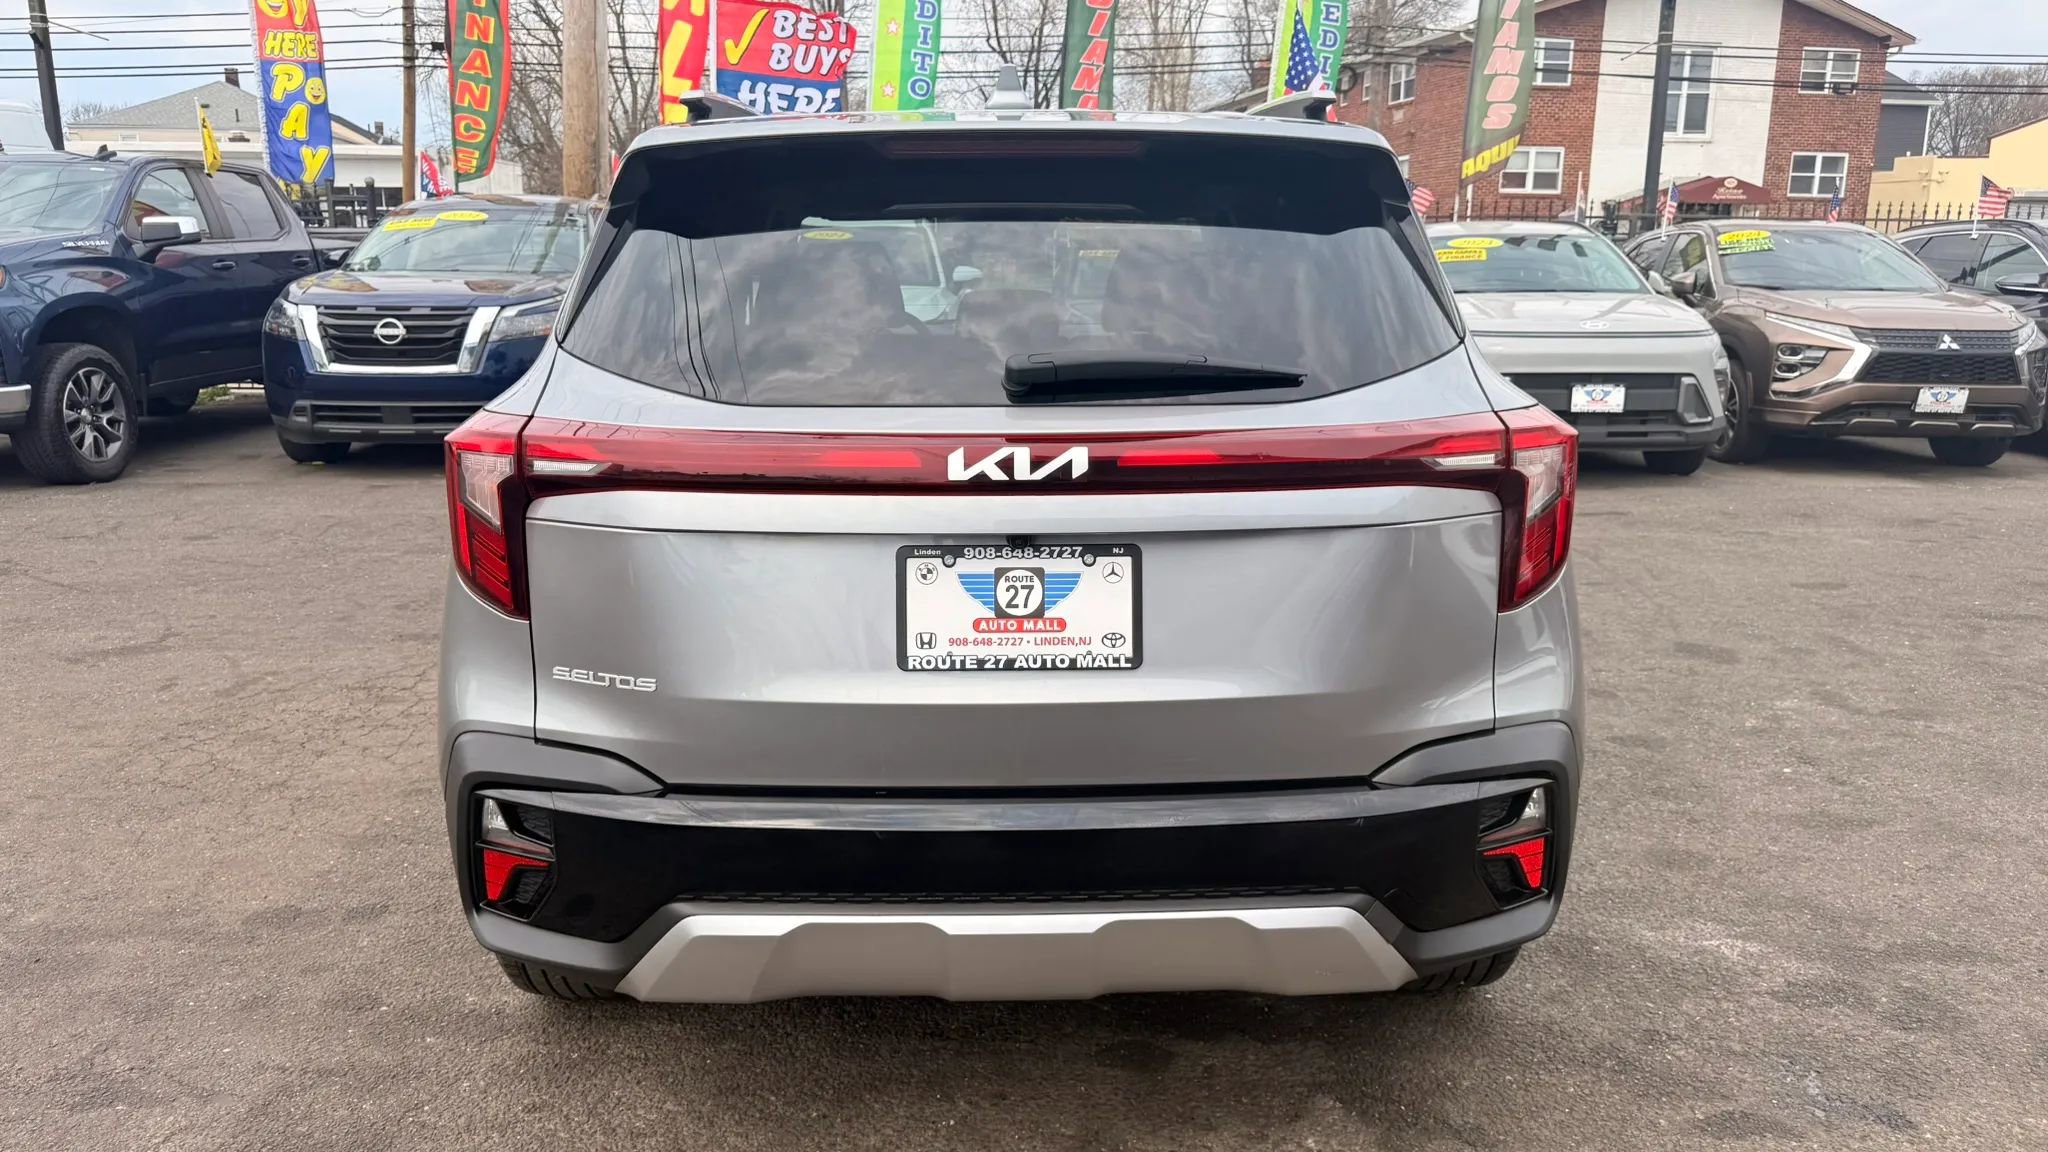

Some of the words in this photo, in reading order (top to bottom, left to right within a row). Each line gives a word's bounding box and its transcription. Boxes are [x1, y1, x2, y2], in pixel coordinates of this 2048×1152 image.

[773, 9, 849, 43] BEST
[263, 30, 318, 60] HERE
[768, 42, 852, 78] BUYS
[270, 61, 332, 186] PAY
[947, 446, 1089, 481] KIA
[914, 548, 941, 556] Linden
[963, 546, 1083, 560] 908-648-2727
[1004, 575, 1035, 583] ROUTE
[1005, 585, 1035, 609] 27
[979, 619, 1017, 631] AUTO
[1023, 618, 1061, 631] MALL
[948, 637, 1024, 647] 908-648-2727
[1034, 636, 1092, 647] LINDEN,NJ
[907, 655, 978, 669] ROUTE
[983, 655, 1008, 669] 27
[1014, 655, 1071, 669] AUTO
[1076, 654, 1132, 668] MALL
[552, 666, 657, 692] SELTOS
